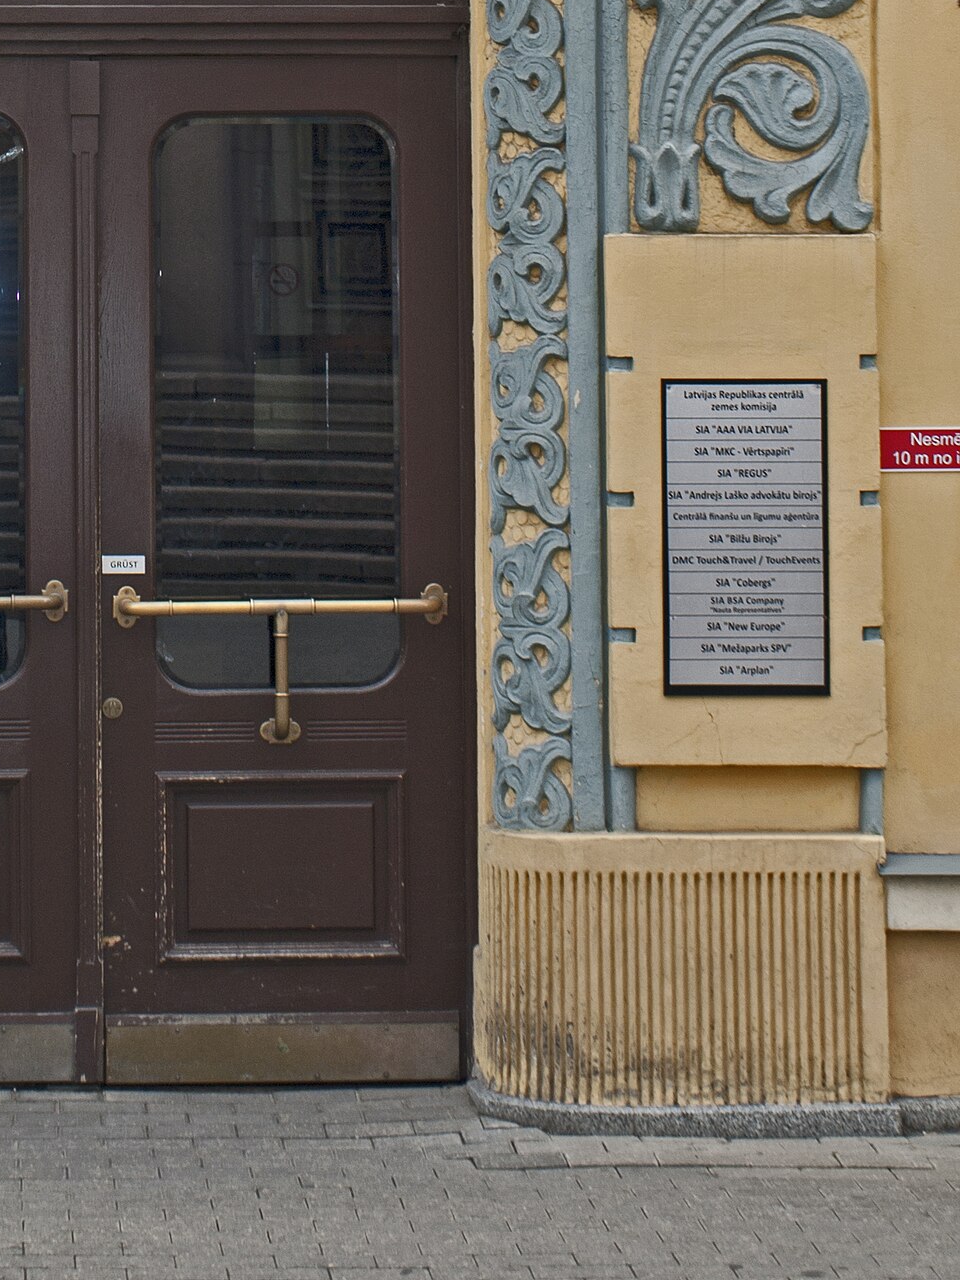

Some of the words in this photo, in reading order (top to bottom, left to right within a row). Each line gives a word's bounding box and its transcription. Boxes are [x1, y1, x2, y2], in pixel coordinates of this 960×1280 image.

[684, 391, 717, 400] Latvijas
[719, 391, 766, 400] Republikas
[741, 402, 777, 412] komisija
[712, 425, 735, 433] "AAA
[755, 425, 792, 433] LATVIJA"
[711, 447, 735, 455] "MKC
[893, 451, 911, 465] 10
[915, 454, 929, 465] m
[933, 454, 953, 465] no
[718, 469, 731, 477] SIA
[734, 469, 772, 477] "REGUS"
[669, 491, 682, 499] SIA
[685, 491, 722, 501] "Andrejs
[751, 491, 790, 499] advokātu
[793, 491, 821, 501] birojs"
[709, 512, 739, 520] finanšu
[709, 535, 723, 543] SIA
[672, 556, 693, 564] DMC
[697, 556, 756, 564] Touch&Travel
[766, 556, 820, 564] TouchEvents
[716, 579, 730, 587] SIA
[732, 578, 776, 588] "Cobergs"
[727, 596, 744, 604] BSA
[746, 596, 784, 606] Company
[708, 622, 722, 630] SIA
[724, 622, 748, 630] "New
[751, 622, 785, 632] Europe"
[701, 644, 715, 652] SIA
[771, 644, 792, 652] SPV"
[720, 666, 734, 674] SIA
[736, 666, 773, 676] "Arplan"
